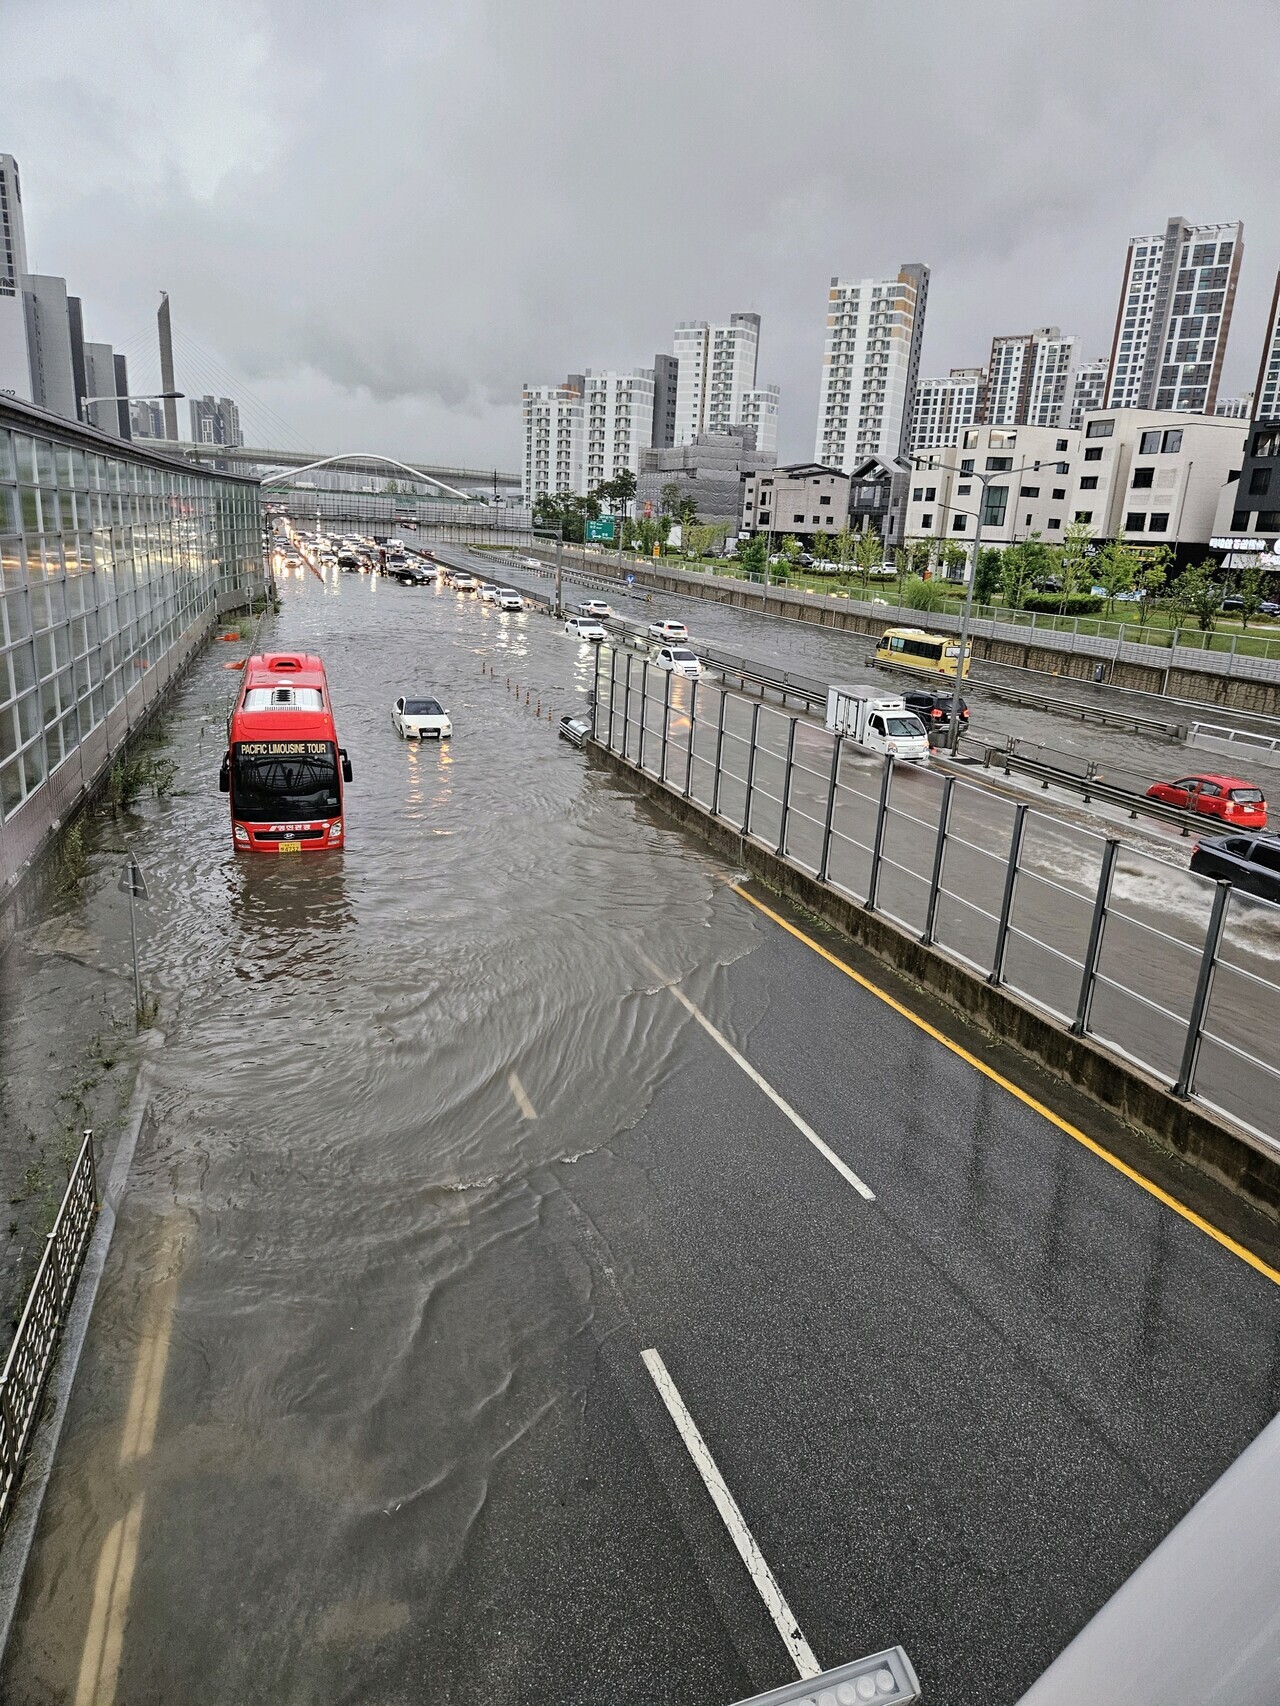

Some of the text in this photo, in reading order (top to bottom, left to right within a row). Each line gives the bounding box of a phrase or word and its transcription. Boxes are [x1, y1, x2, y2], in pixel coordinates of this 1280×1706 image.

[241, 743, 326, 754] PACIFIC LIMOUSINE TOUR
